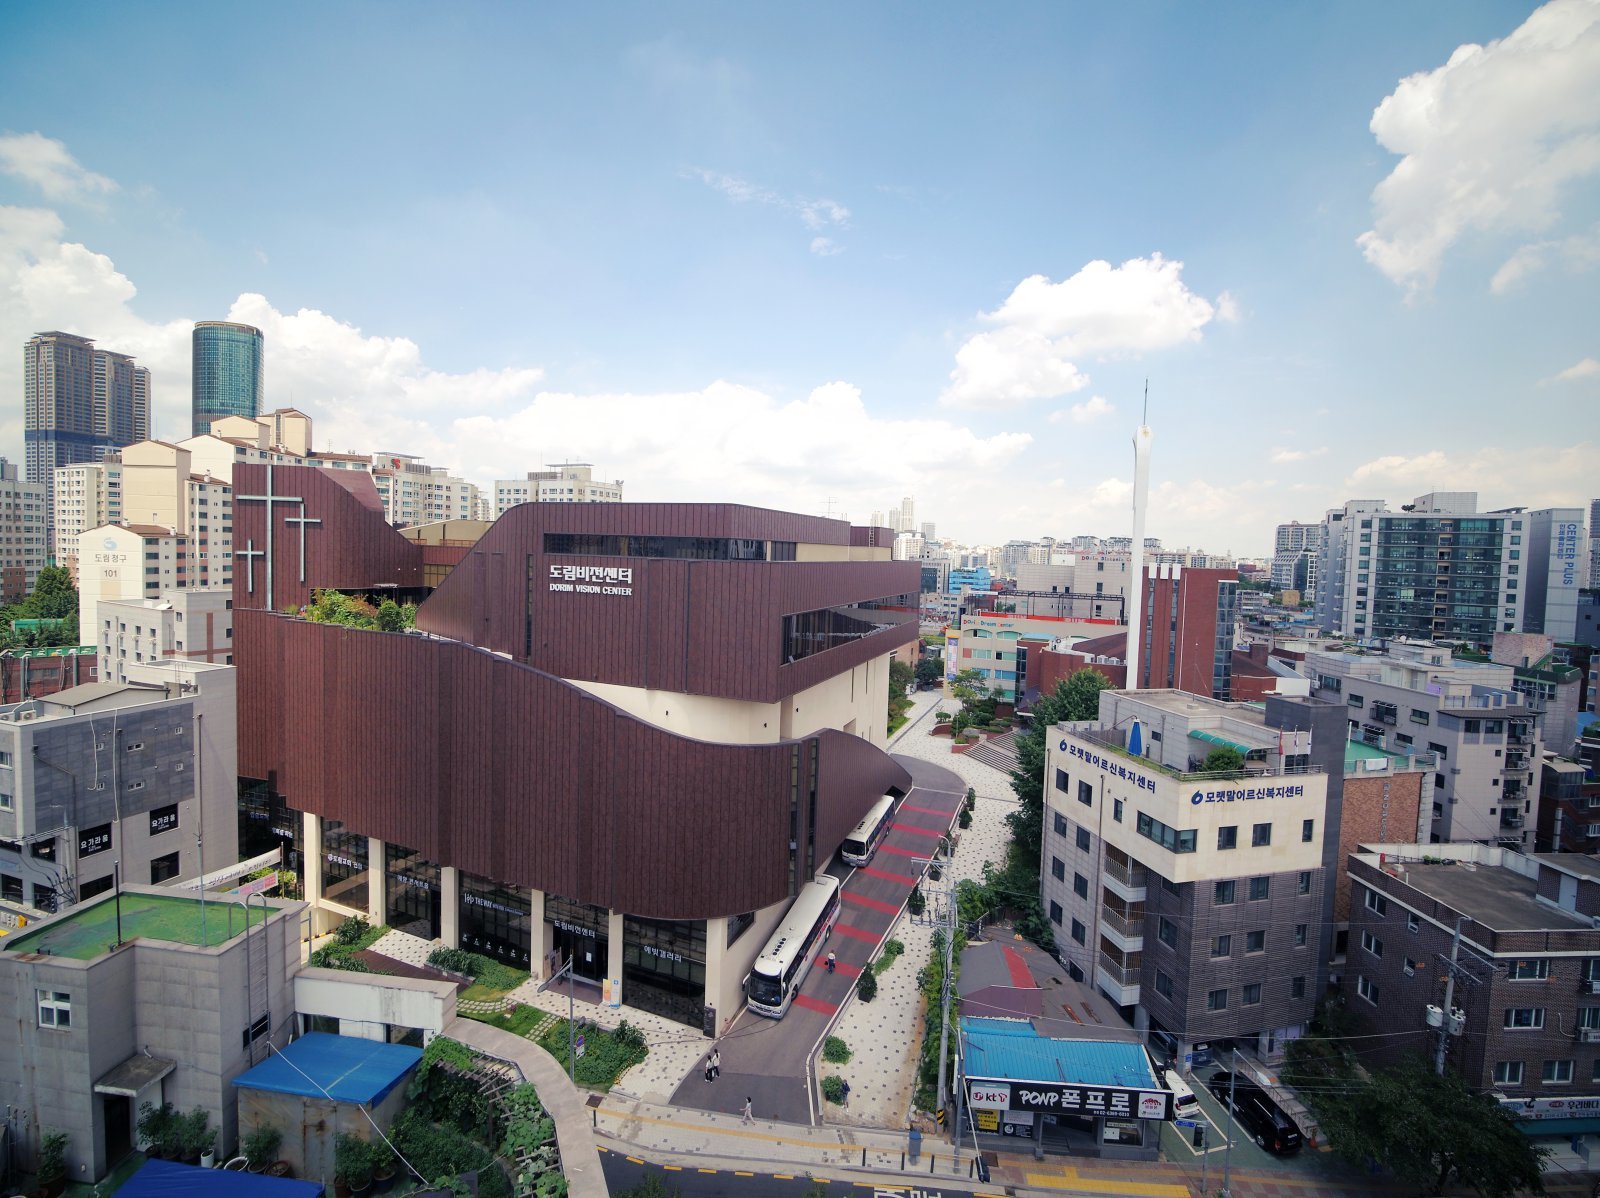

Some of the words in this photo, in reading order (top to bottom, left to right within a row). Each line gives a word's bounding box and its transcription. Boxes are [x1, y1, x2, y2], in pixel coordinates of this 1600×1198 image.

[1564, 523, 1577, 560] CENTER
[104, 569, 118, 578] 101
[549, 565, 632, 584] 도림비전센터
[1563, 561, 1574, 585] PLUS
[549, 583, 574, 592] DORIM
[576, 584, 601, 594] VISION
[602, 586, 632, 596] CENTER
[1205, 785, 1304, 803] 모랫말어르신복지센터
[1061, 1088, 1130, 1112] 폰프로
